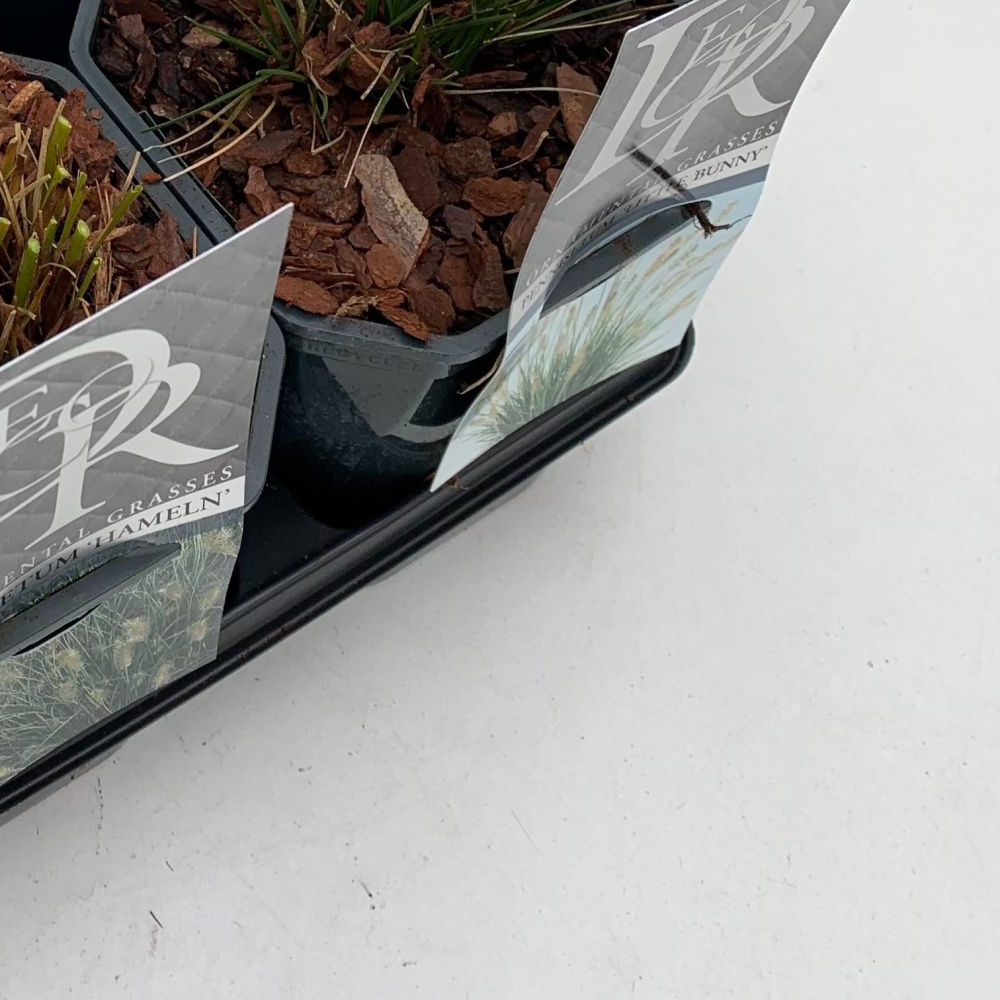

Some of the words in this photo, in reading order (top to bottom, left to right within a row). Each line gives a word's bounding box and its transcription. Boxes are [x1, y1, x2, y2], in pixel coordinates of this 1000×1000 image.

[676, 120, 779, 172] GRASSES
[693, 145, 769, 182] BUNNY'
[86, 488, 232, 549] 'HAMELN'
[106, 463, 234, 524] GRASSES
